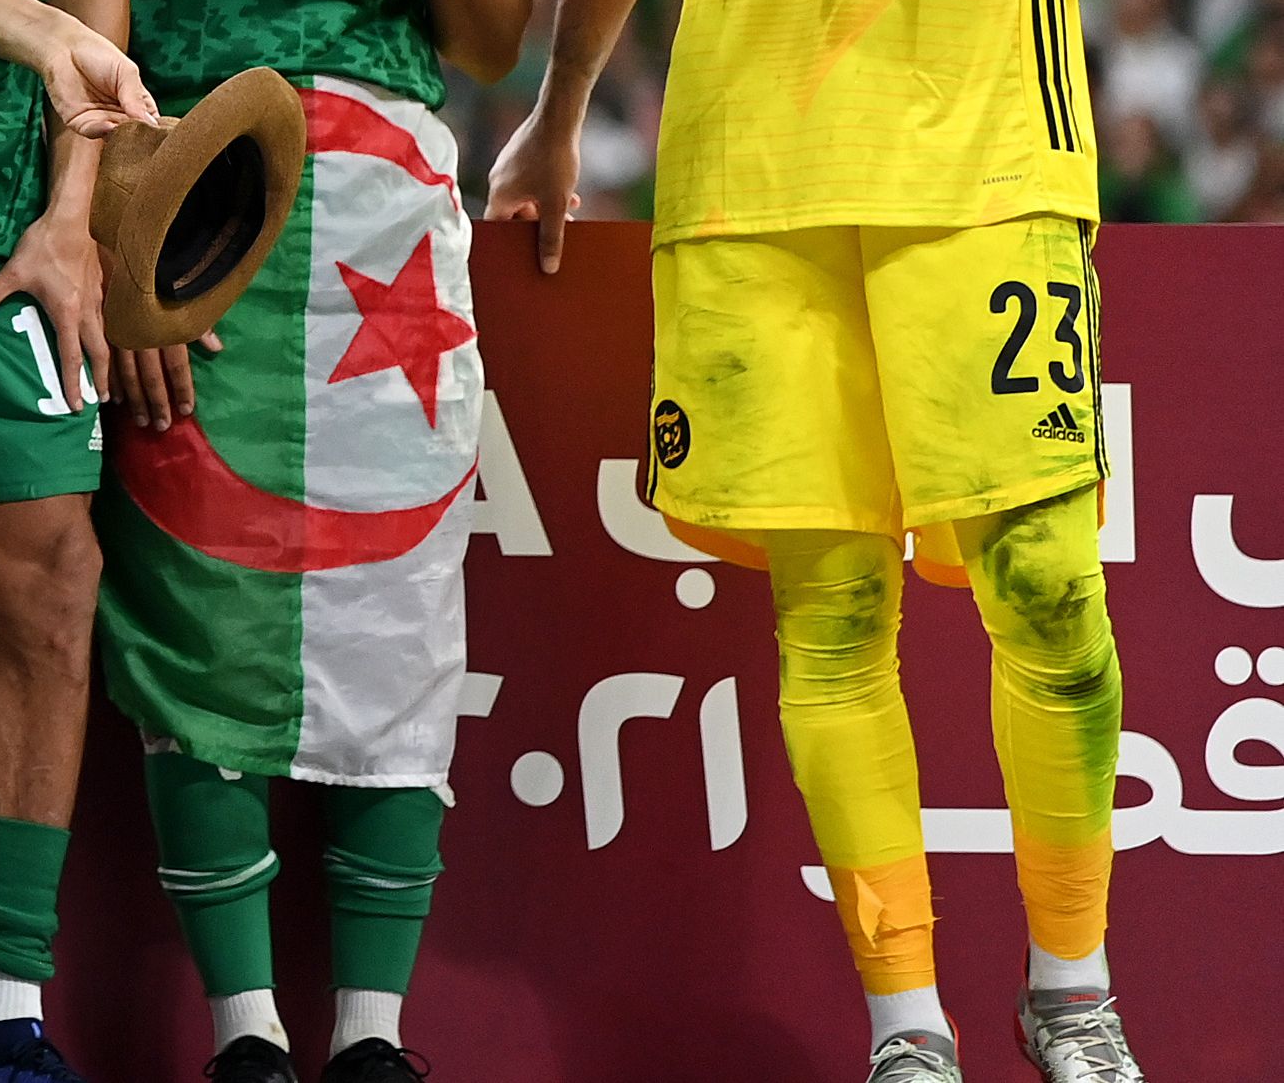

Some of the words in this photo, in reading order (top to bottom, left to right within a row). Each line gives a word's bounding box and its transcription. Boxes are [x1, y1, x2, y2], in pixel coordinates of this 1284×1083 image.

[11, 305, 99, 415] 1
[990, 281, 1084, 395] 23
[1032, 427, 1085, 443] adidas
